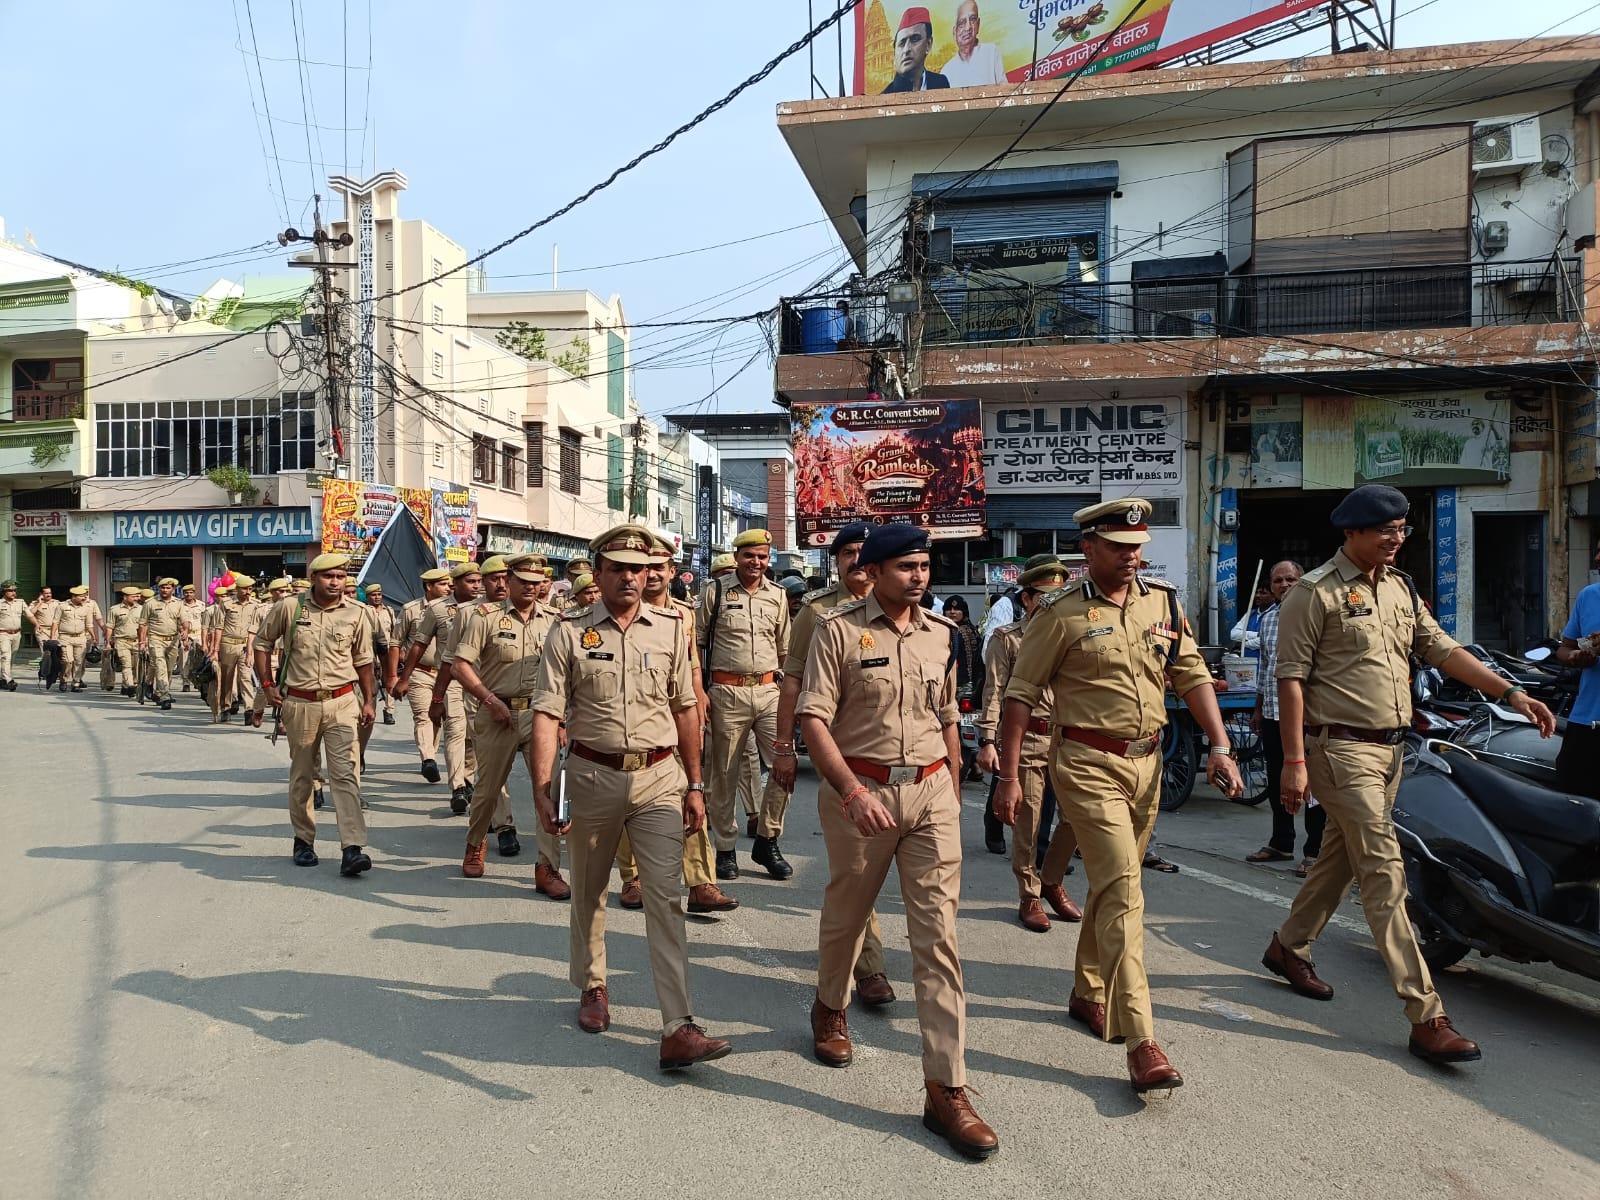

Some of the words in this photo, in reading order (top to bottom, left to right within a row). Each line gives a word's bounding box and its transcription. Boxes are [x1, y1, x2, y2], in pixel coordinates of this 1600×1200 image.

[1112, 22, 1150, 49] बंसल
[1002, 247, 1038, 260] Dream
[1041, 245, 1071, 257] tudio
[836, 411, 849, 421] St.
[851, 410, 863, 420] R.
[863, 410, 874, 419] C.
[875, 408, 912, 419] Convent
[913, 407, 940, 417] School
[997, 404, 1166, 434] CLINIC
[982, 435, 1092, 450] TREATMENT
[1098, 432, 1166, 447] CENTRE
[877, 446, 907, 461] Grand
[1003, 450, 1046, 466] रोग
[1131, 446, 1176, 465] केन्द्र
[858, 458, 929, 481] Ramleela
[1100, 464, 1135, 481] वर्मा
[366, 501, 392, 511] Diwali
[442, 490, 469, 506] शामली
[869, 496, 888, 506] Good
[906, 494, 921, 503] Evil
[14, 510, 61, 529] शास्त्री
[116, 513, 202, 539] RAGHAV
[206, 512, 252, 538] GIFT
